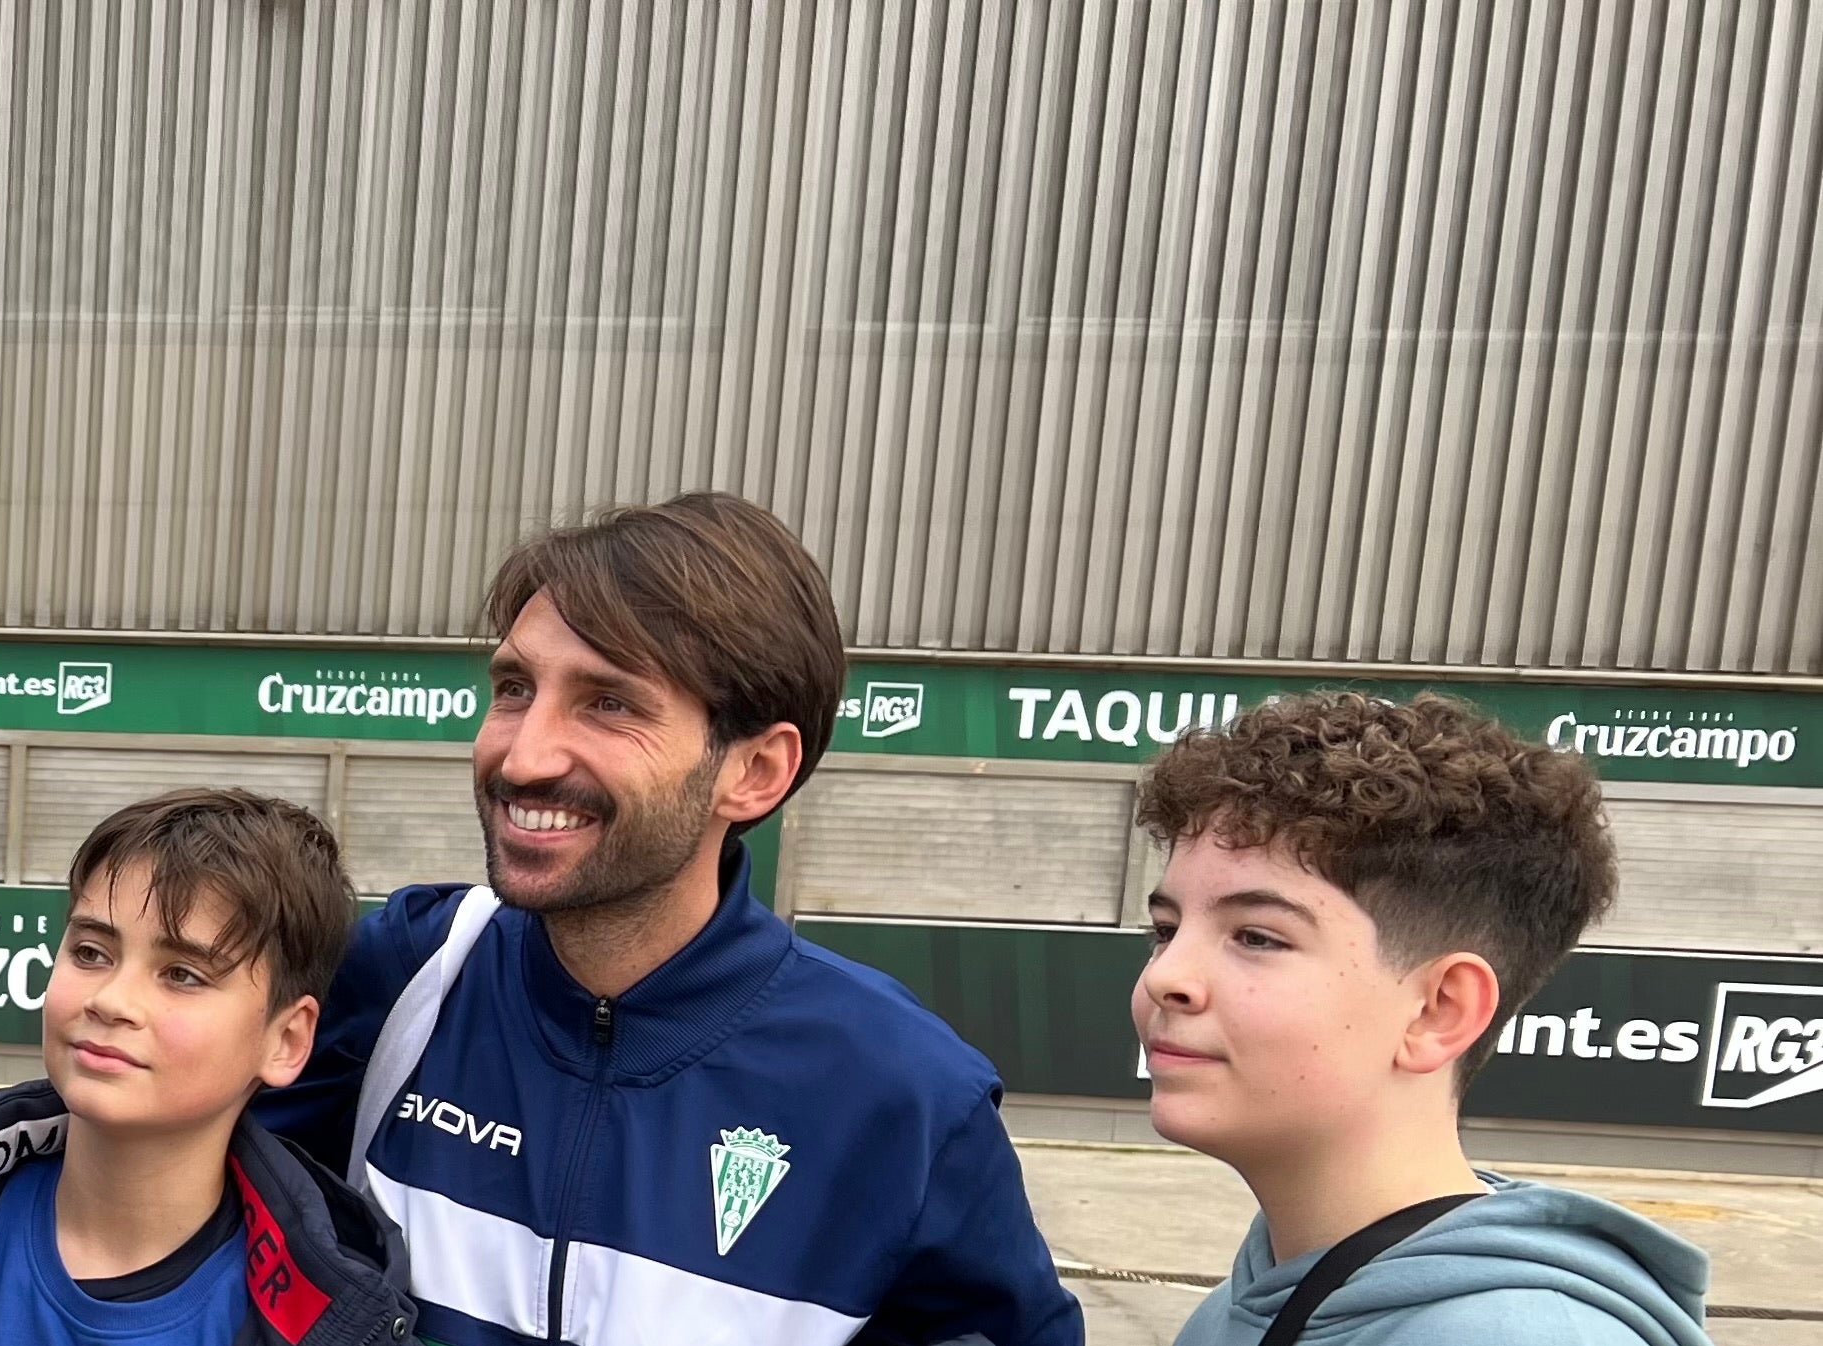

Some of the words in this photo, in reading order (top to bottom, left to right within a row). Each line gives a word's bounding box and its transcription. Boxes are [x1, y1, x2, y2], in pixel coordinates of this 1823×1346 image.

[63, 674, 105, 700] RG3
[258, 672, 477, 725] Cruzcampo
[869, 695, 916, 722] RG3
[1547, 712, 1796, 768] Cruzcampo
